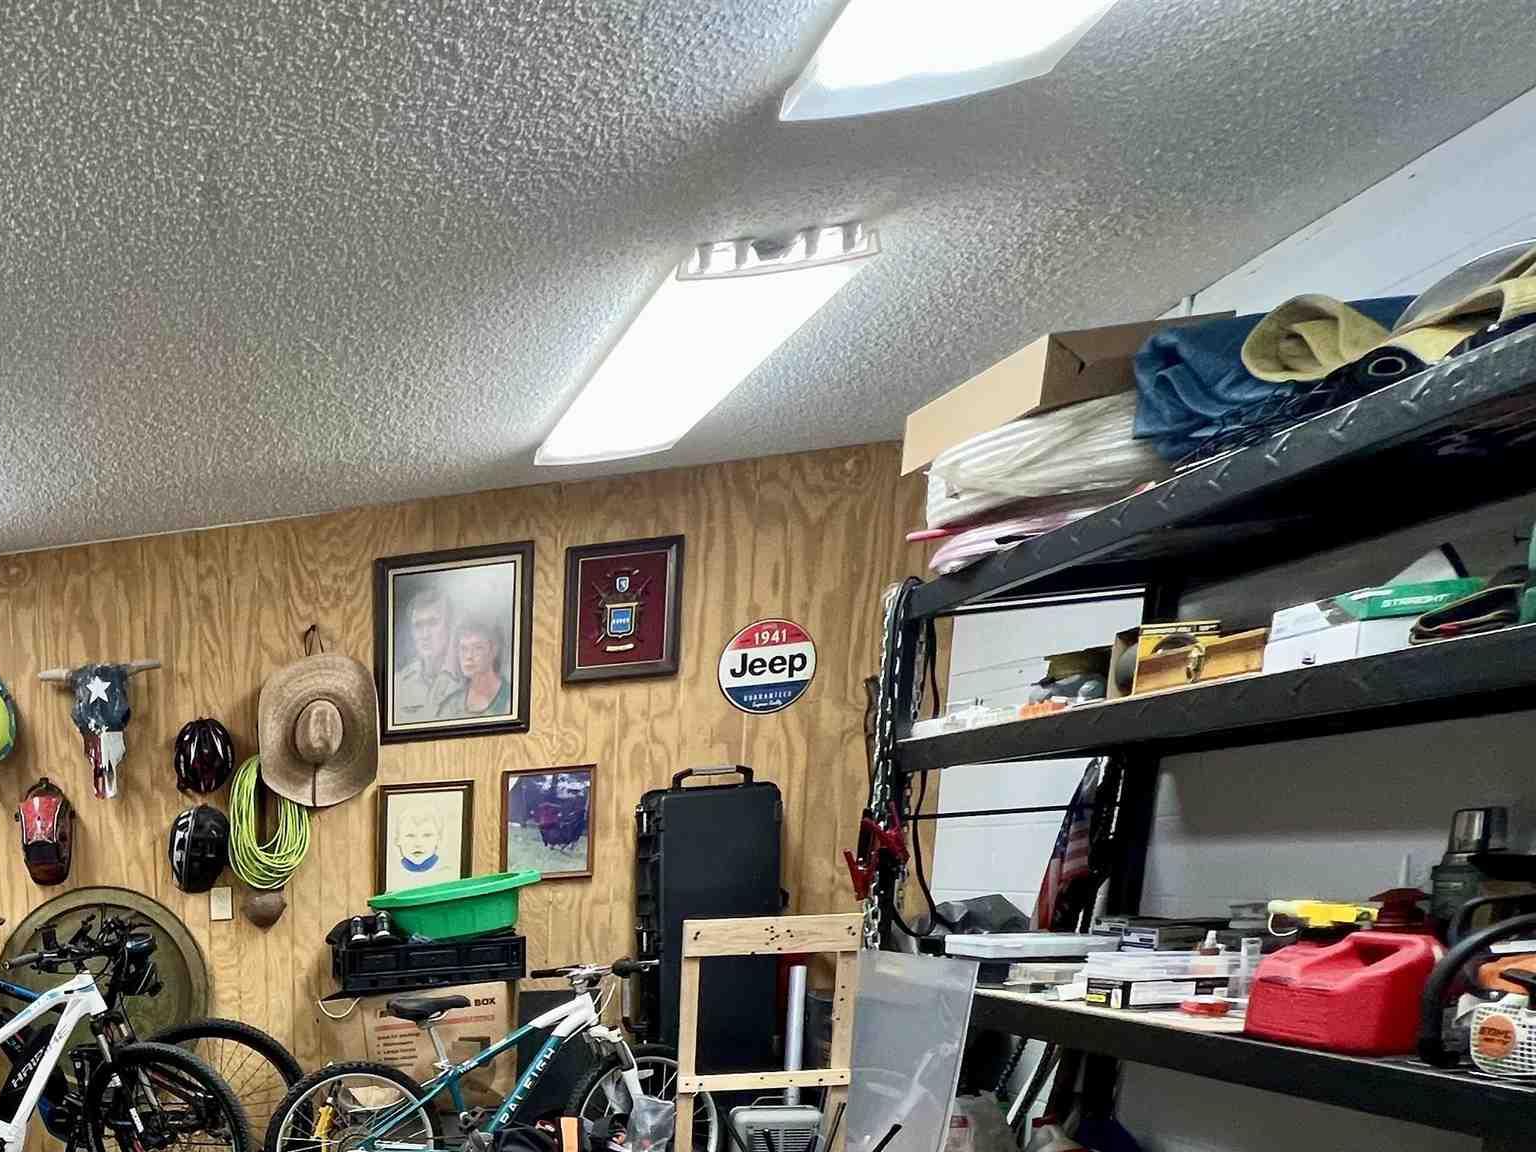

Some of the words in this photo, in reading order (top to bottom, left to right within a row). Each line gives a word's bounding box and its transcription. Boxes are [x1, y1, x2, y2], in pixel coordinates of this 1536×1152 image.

[754, 628, 787, 645] 1941
[730, 652, 807, 678] Jeep
[474, 997, 496, 1007] BOX
[498, 1048, 557, 1125] RALEIGH
